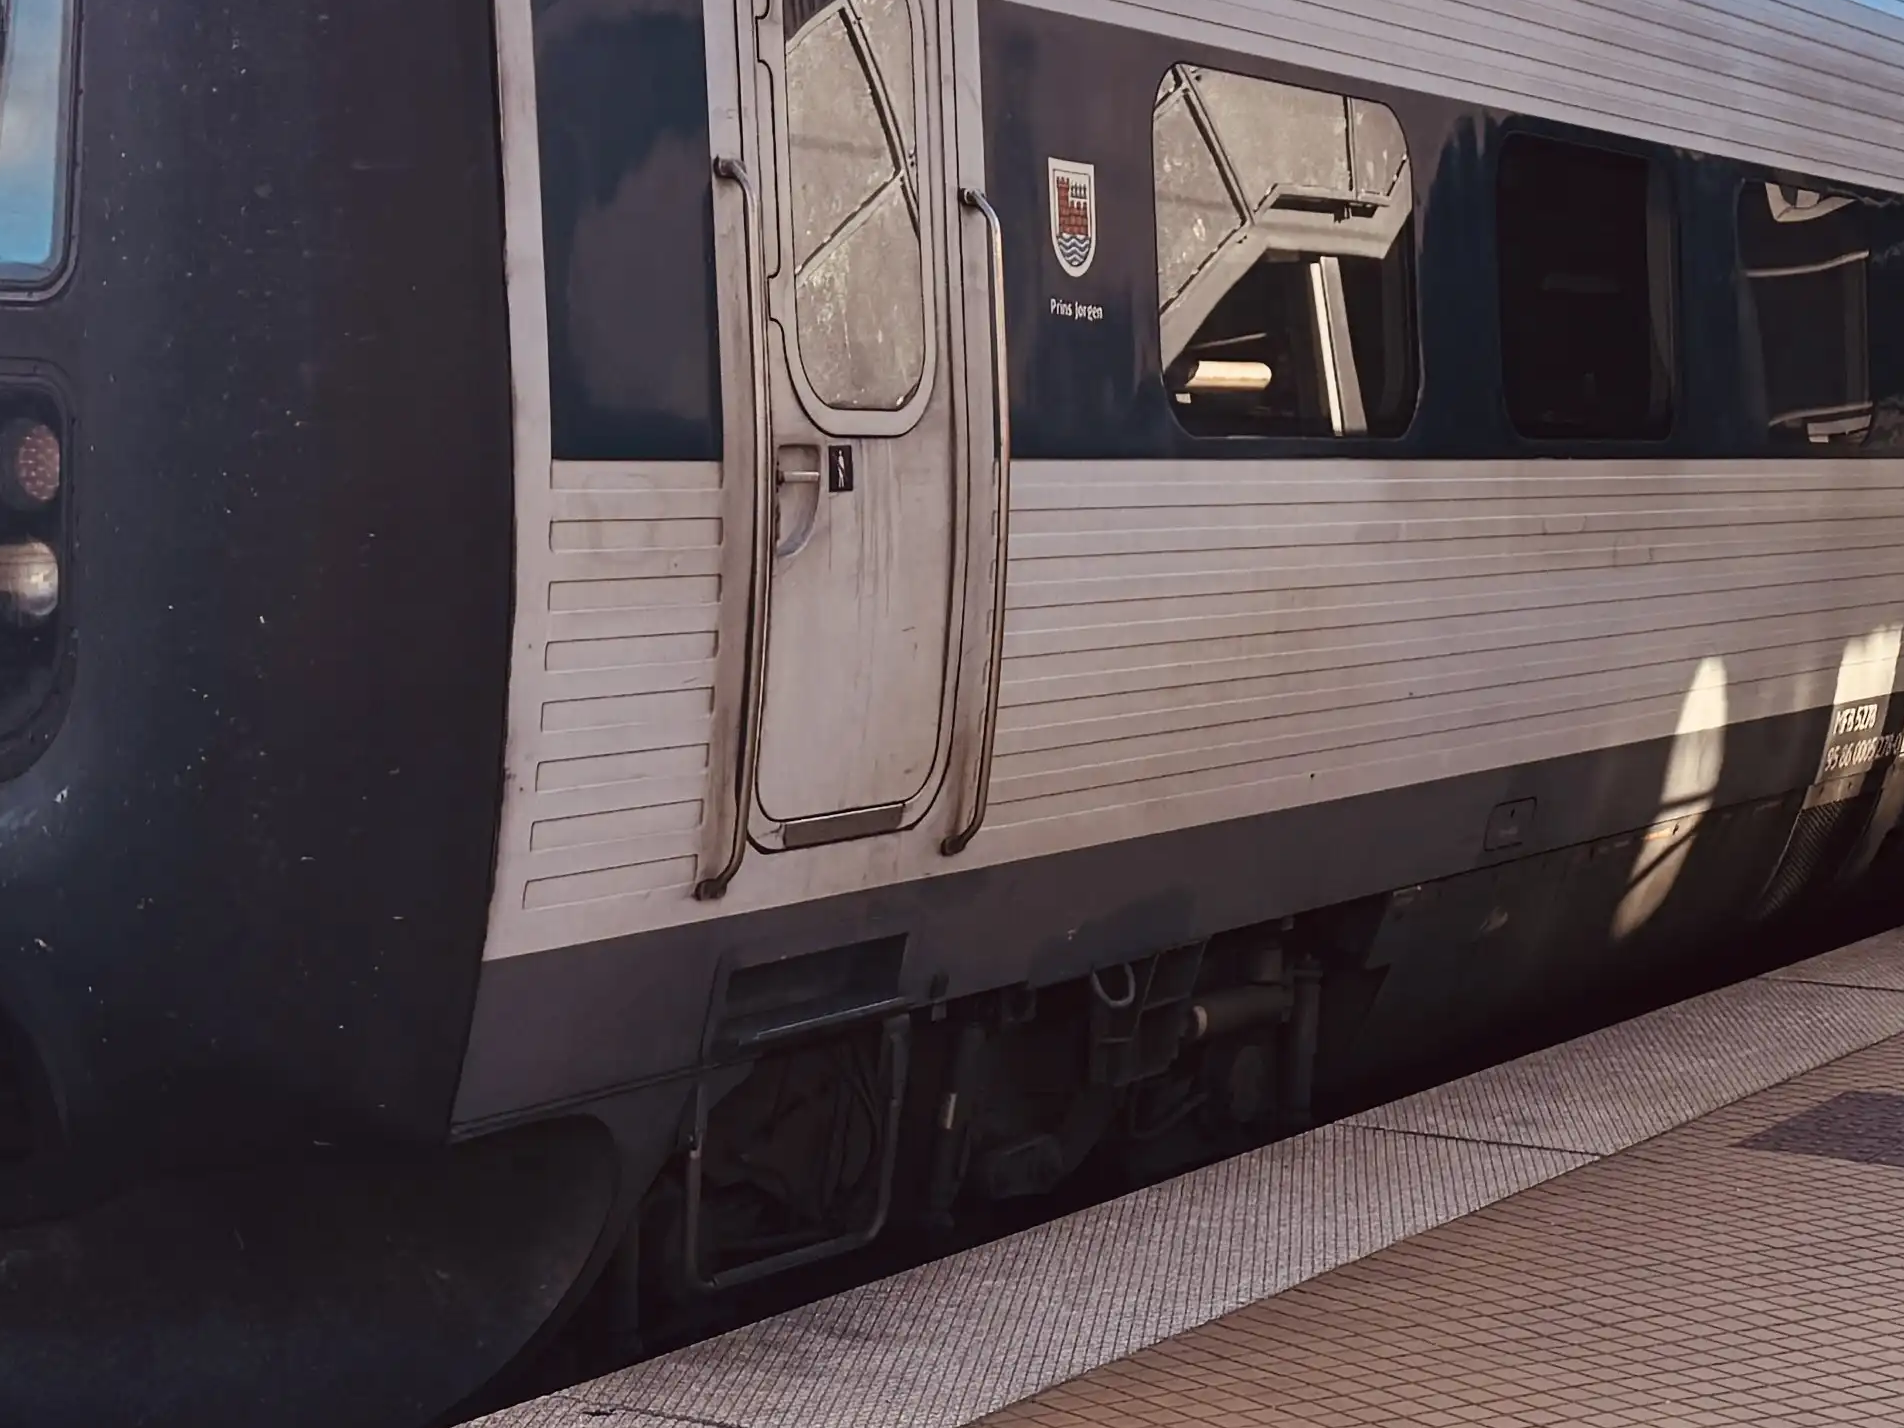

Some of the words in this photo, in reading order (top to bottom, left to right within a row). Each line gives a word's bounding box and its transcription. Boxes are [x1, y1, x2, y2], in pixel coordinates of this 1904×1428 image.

[1050, 298, 1073, 316] Prins
[1833, 708, 1856, 736] MFB
[1855, 703, 1878, 732] 5278
